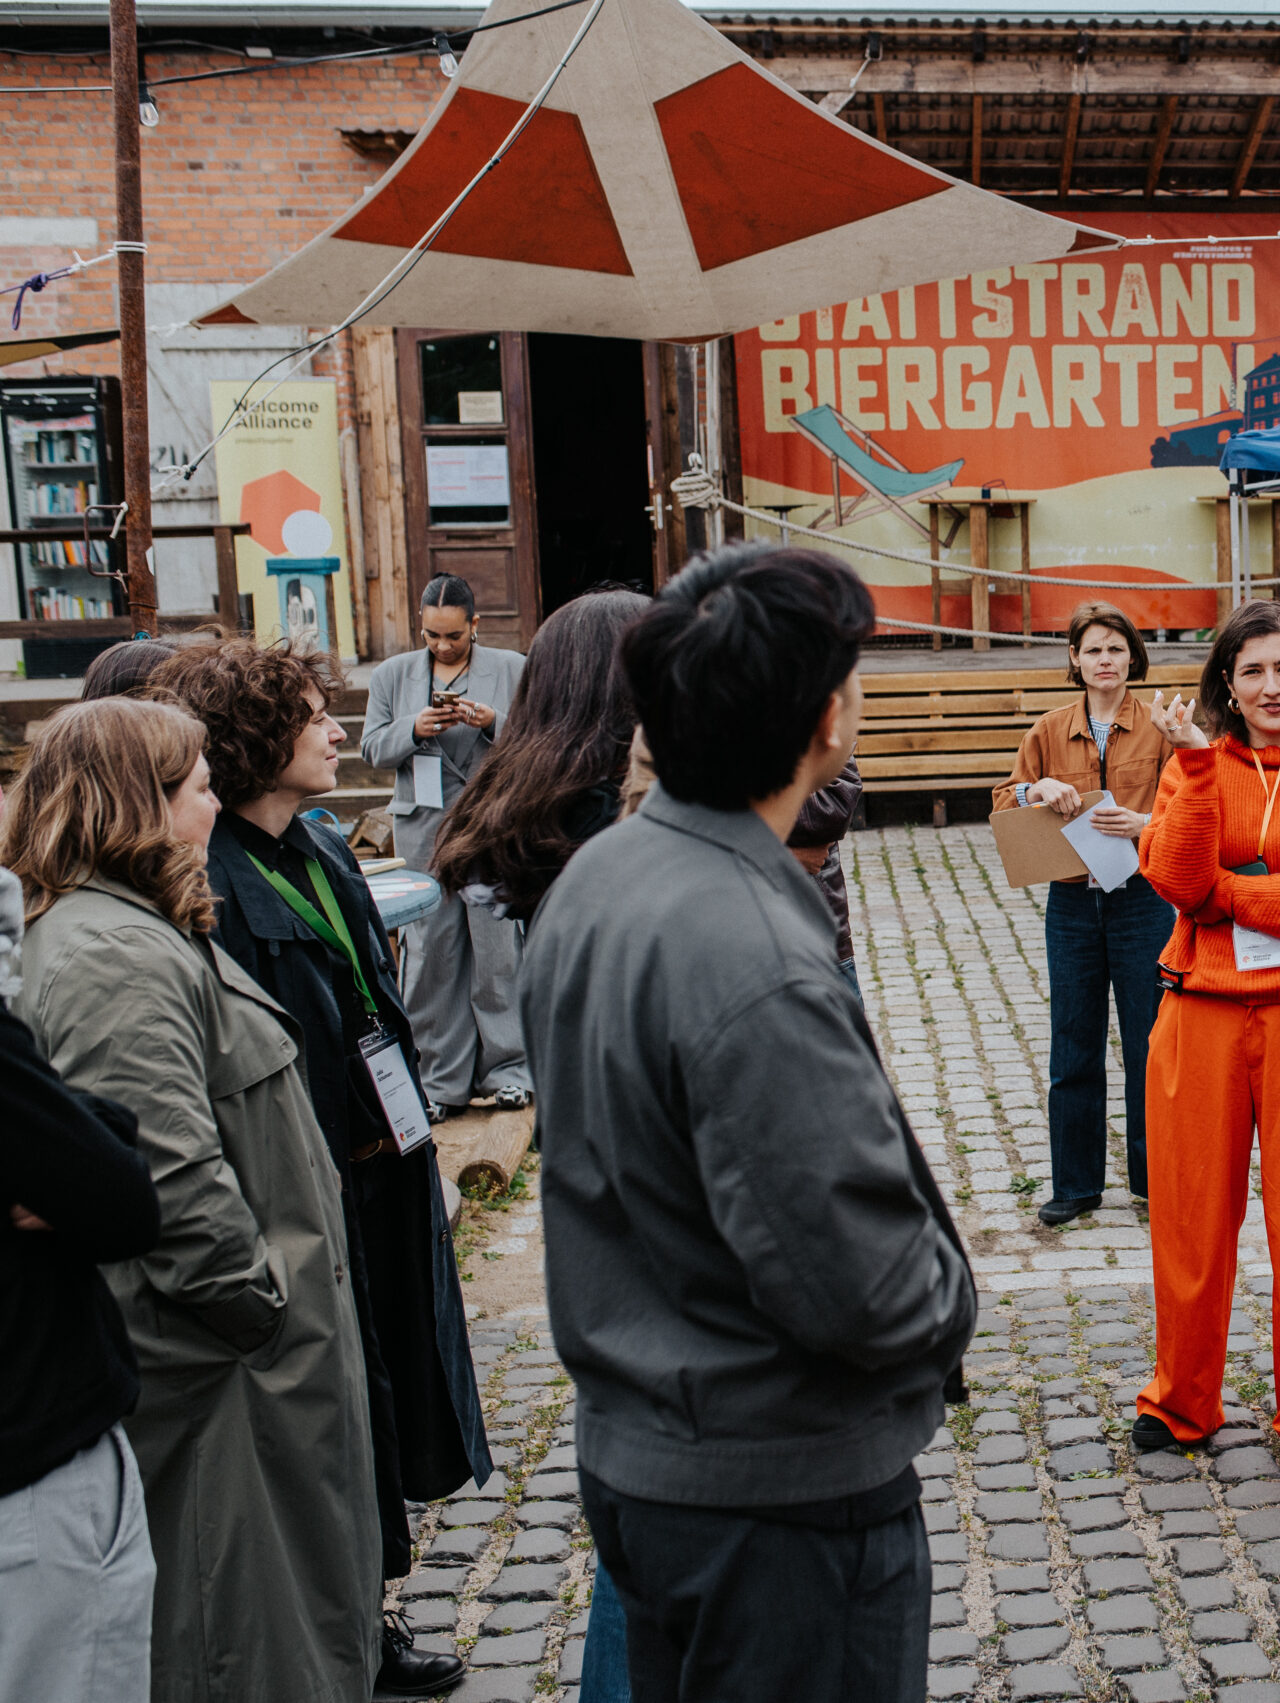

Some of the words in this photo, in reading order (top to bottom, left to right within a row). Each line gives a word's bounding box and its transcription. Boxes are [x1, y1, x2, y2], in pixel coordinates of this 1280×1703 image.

[759, 263, 1256, 341] ATTSTRAND
[233, 398, 319, 413] Welcome
[760, 344, 1256, 432] BIERGARTEN
[235, 414, 312, 429] Alliance
